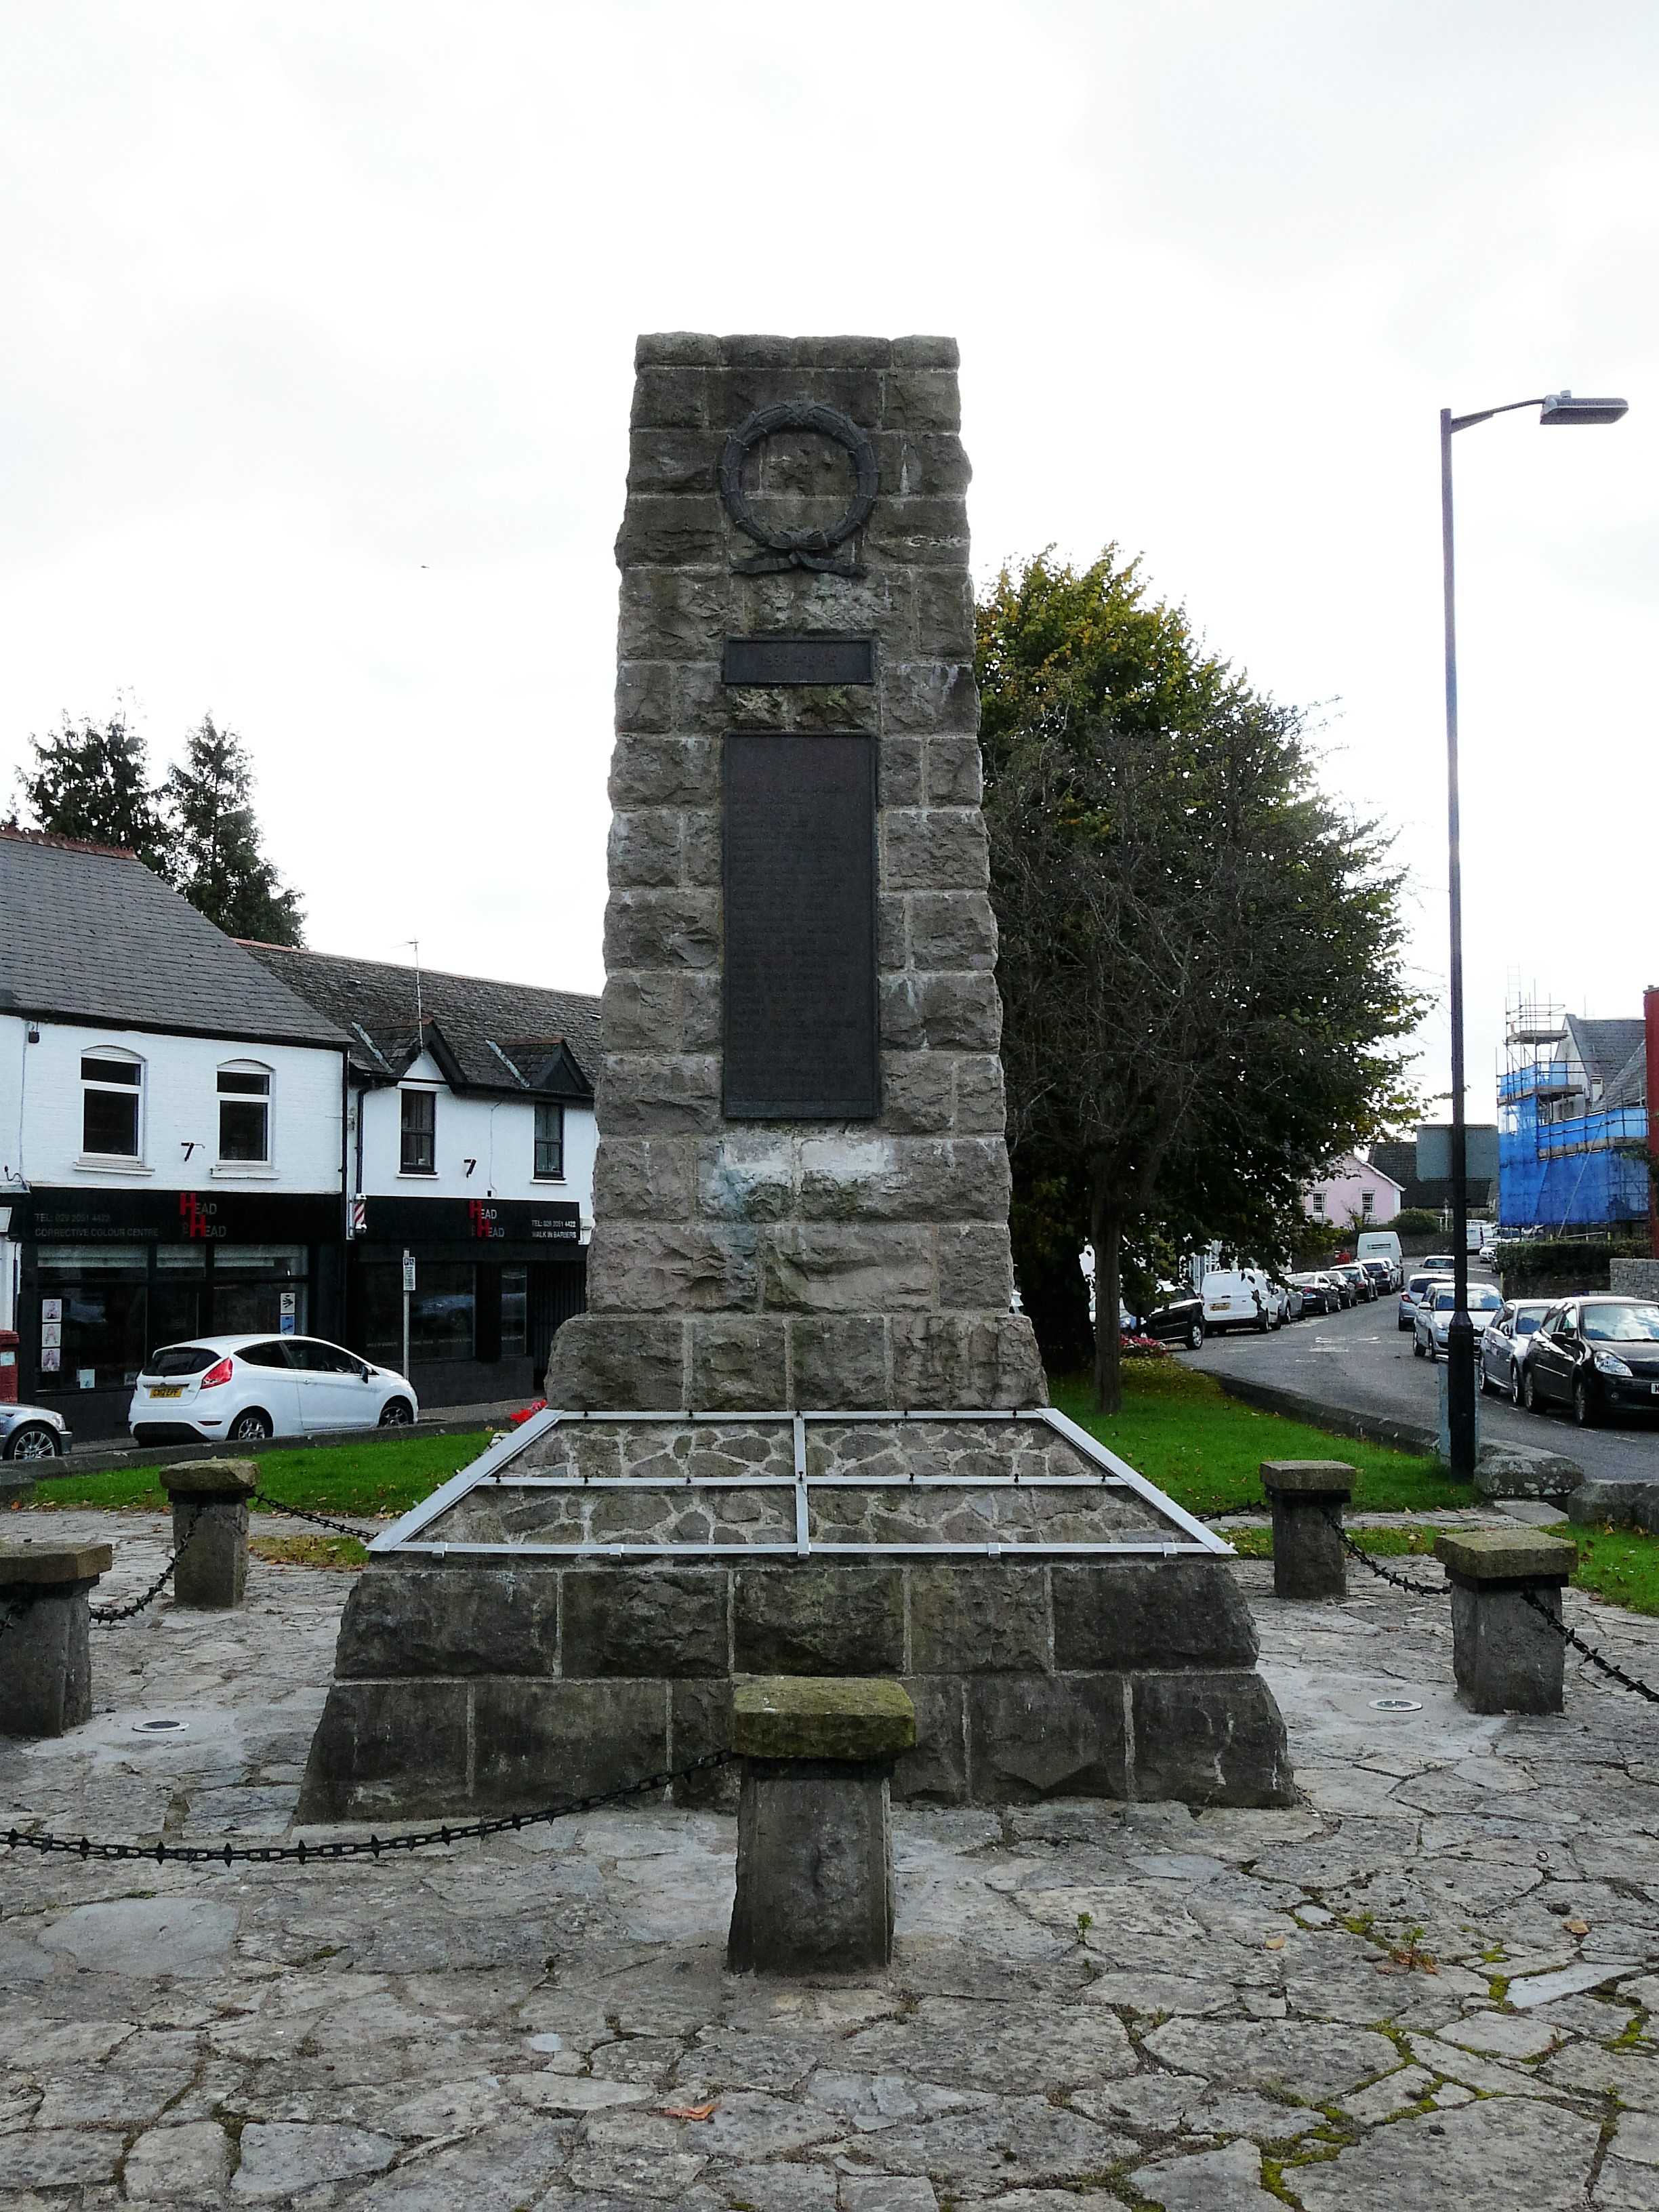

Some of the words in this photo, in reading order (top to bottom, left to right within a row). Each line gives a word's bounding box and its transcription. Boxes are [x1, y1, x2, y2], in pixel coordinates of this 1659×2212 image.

[180, 1192, 218, 1215] HEAD
[468, 1200, 497, 1219] HEAD
[35, 1228, 89, 1237] CORRECTIVE
[91, 1228, 125, 1237] COLOUR
[127, 1227, 159, 1237] CENTRE
[189, 1214, 227, 1238] HEAD
[477, 1218, 505, 1238] HEAD
